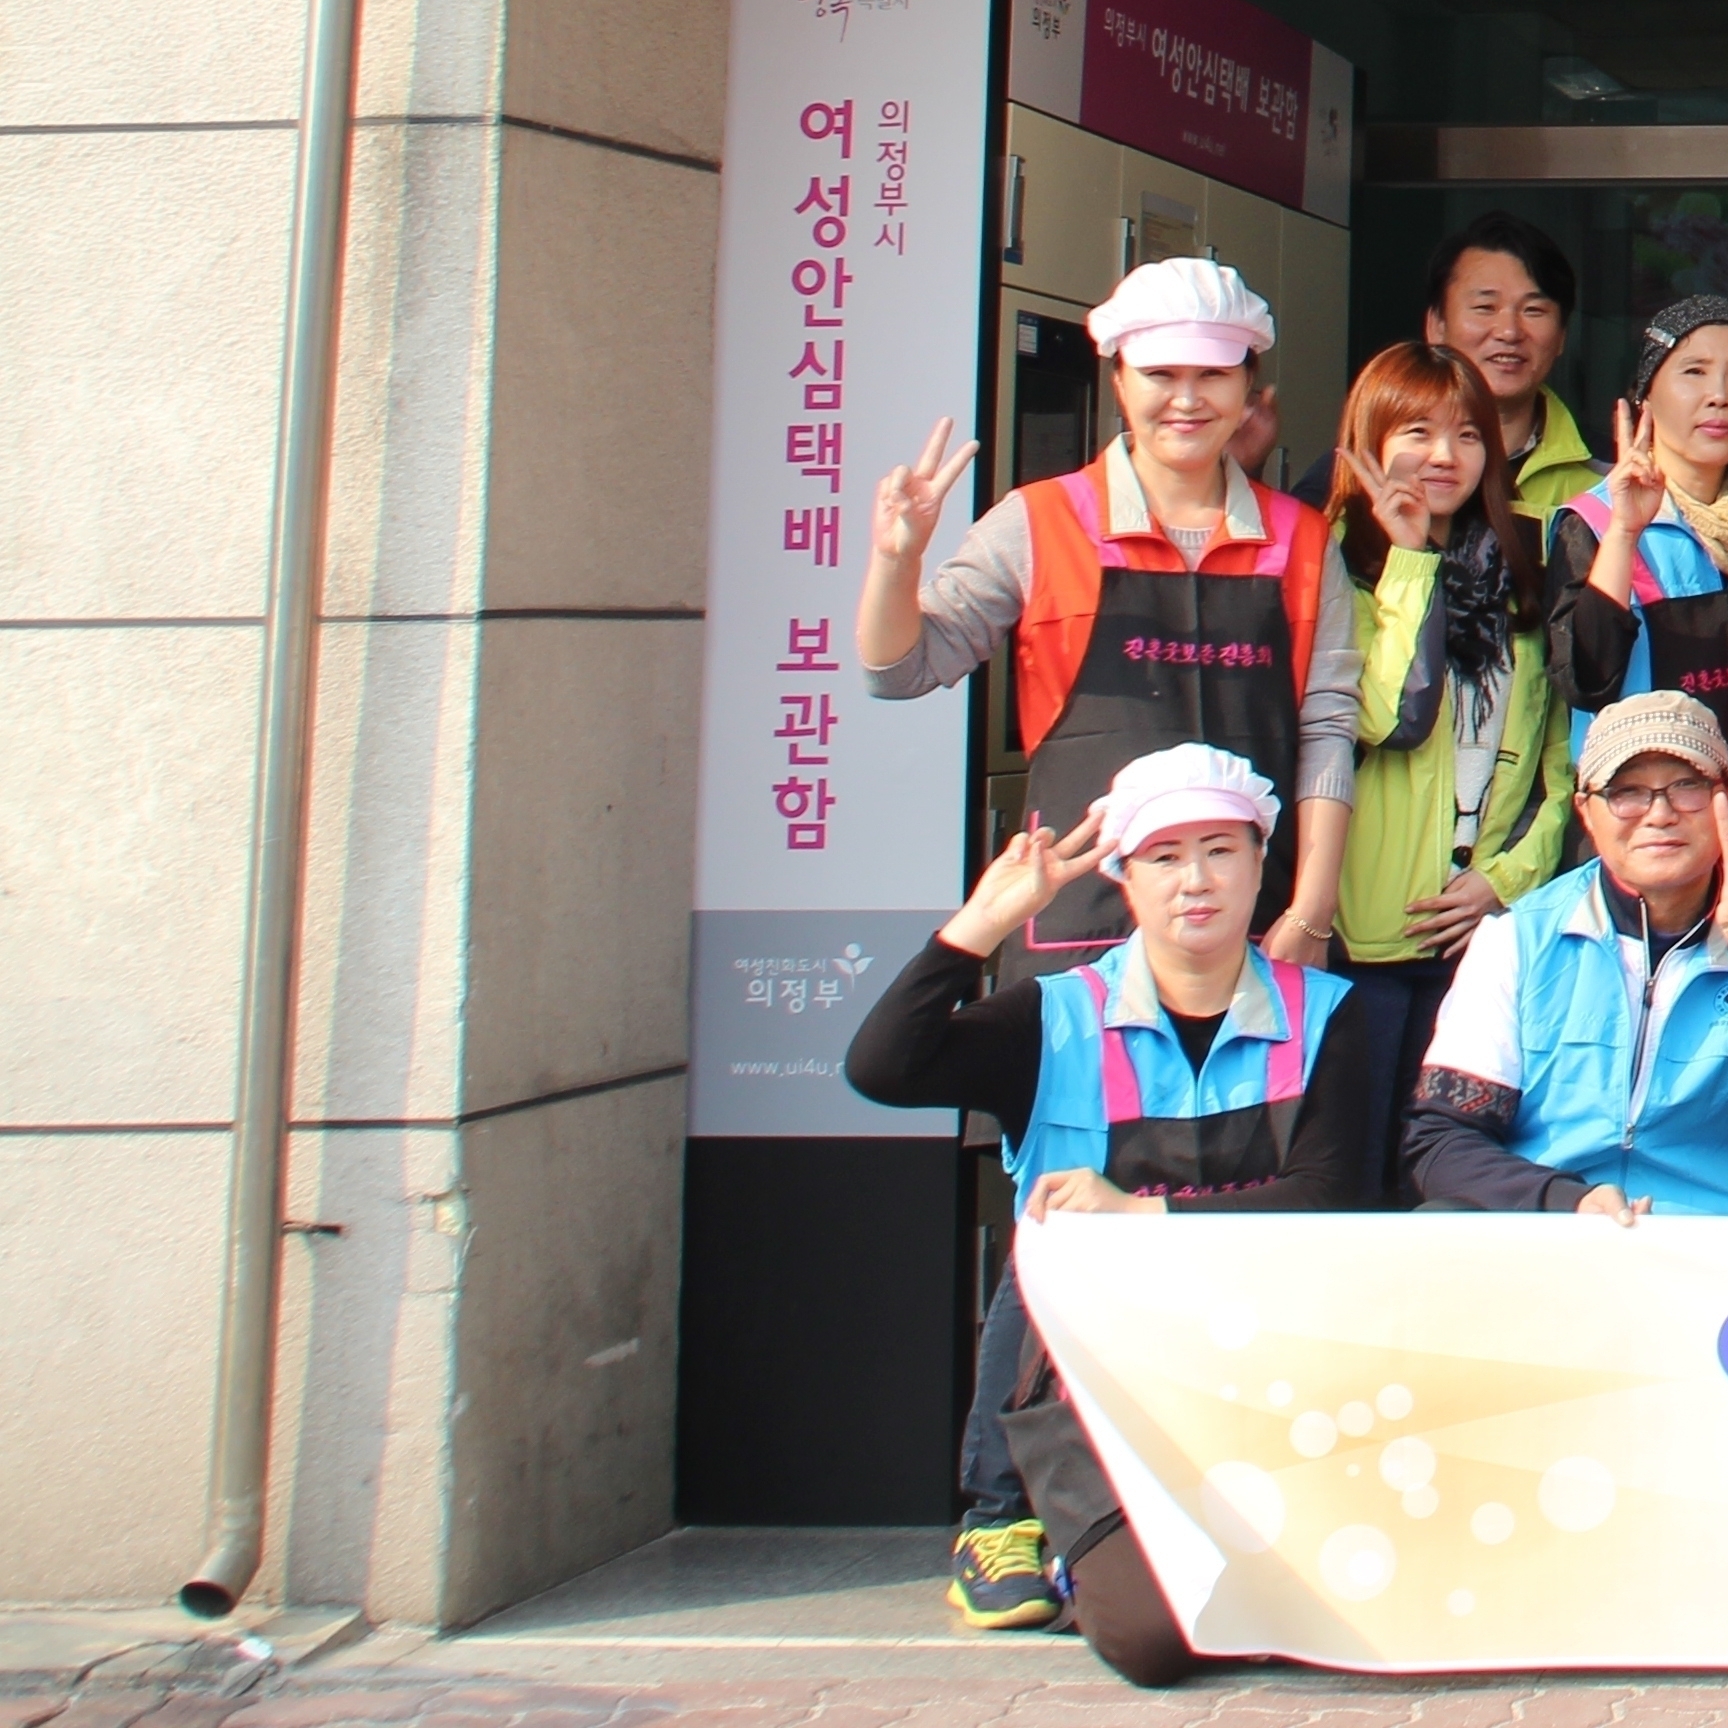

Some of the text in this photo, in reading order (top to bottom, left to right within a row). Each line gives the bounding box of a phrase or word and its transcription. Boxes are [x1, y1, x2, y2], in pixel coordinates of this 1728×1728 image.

[1103, 7, 1147, 51] 의정부시
[1151, 27, 1251, 114] 여성안심택배
[1255, 75, 1298, 141] 보관함
[873, 99, 910, 257] 의정부시
[772, 97, 854, 850] 여성안심택배 보관함
[745, 978, 844, 1014] 의정부
[731, 1057, 845, 1078] www.ui4u.n
